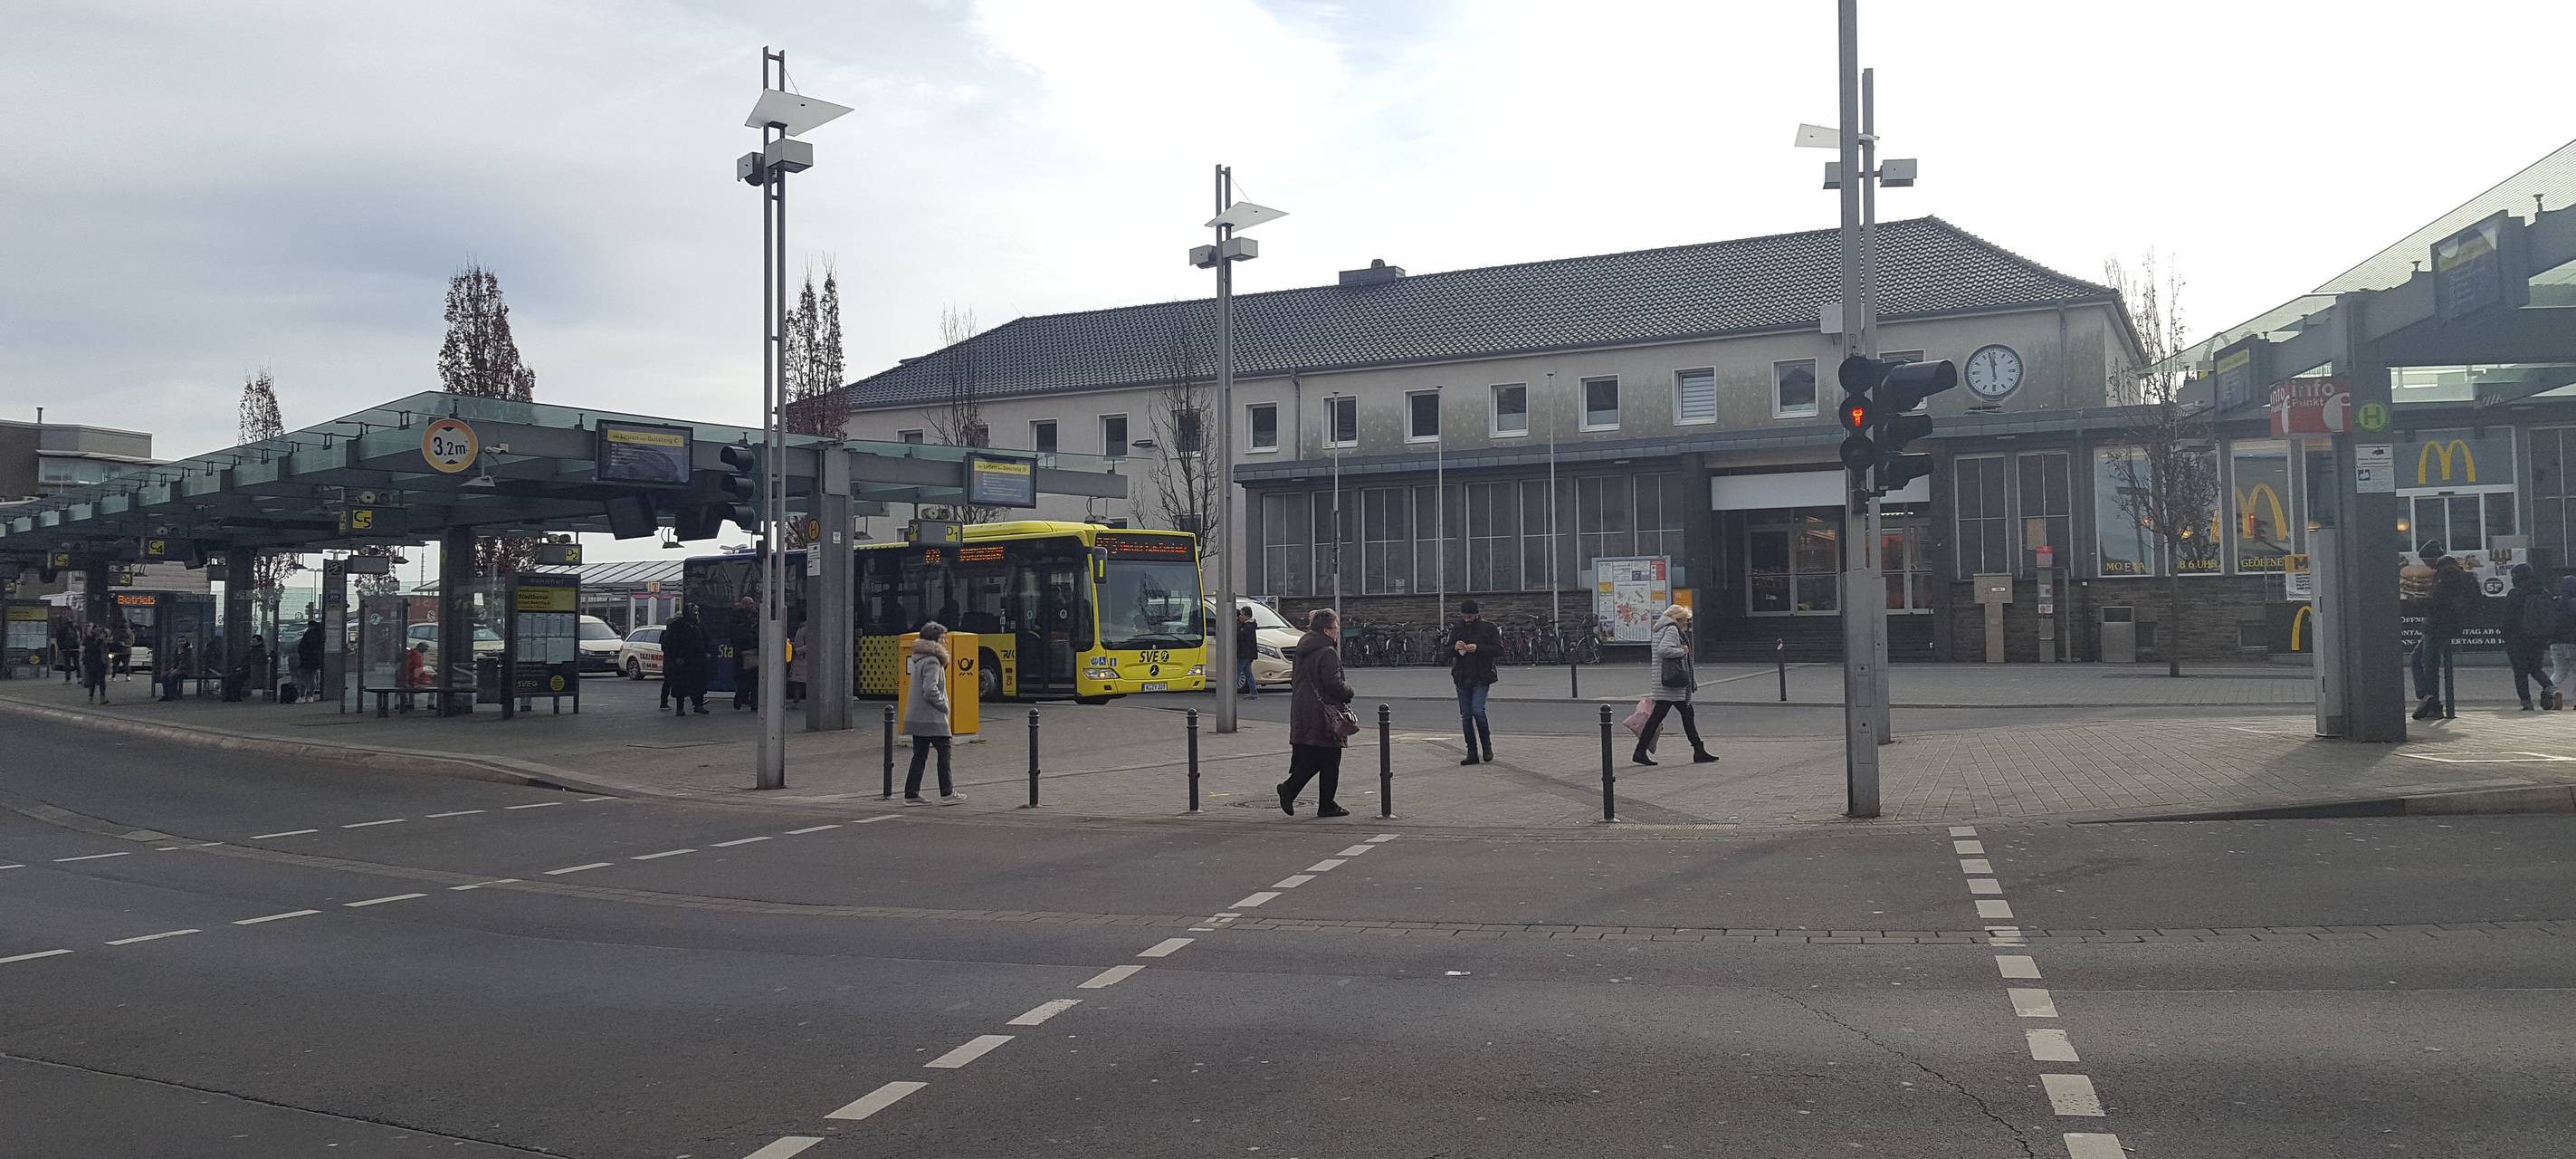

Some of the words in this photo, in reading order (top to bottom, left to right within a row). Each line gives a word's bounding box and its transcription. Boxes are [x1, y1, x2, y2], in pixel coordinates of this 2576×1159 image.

[2291, 378, 2335, 398] info
[2292, 398, 2325, 407] Punkt
[2363, 407, 2382, 425] H
[353, 512, 372, 529] C5
[946, 527, 959, 541] D1
[567, 548, 578, 560] D2
[2241, 556, 2285, 568] GEÖFFNE
[1140, 651, 1159, 662] SVE
